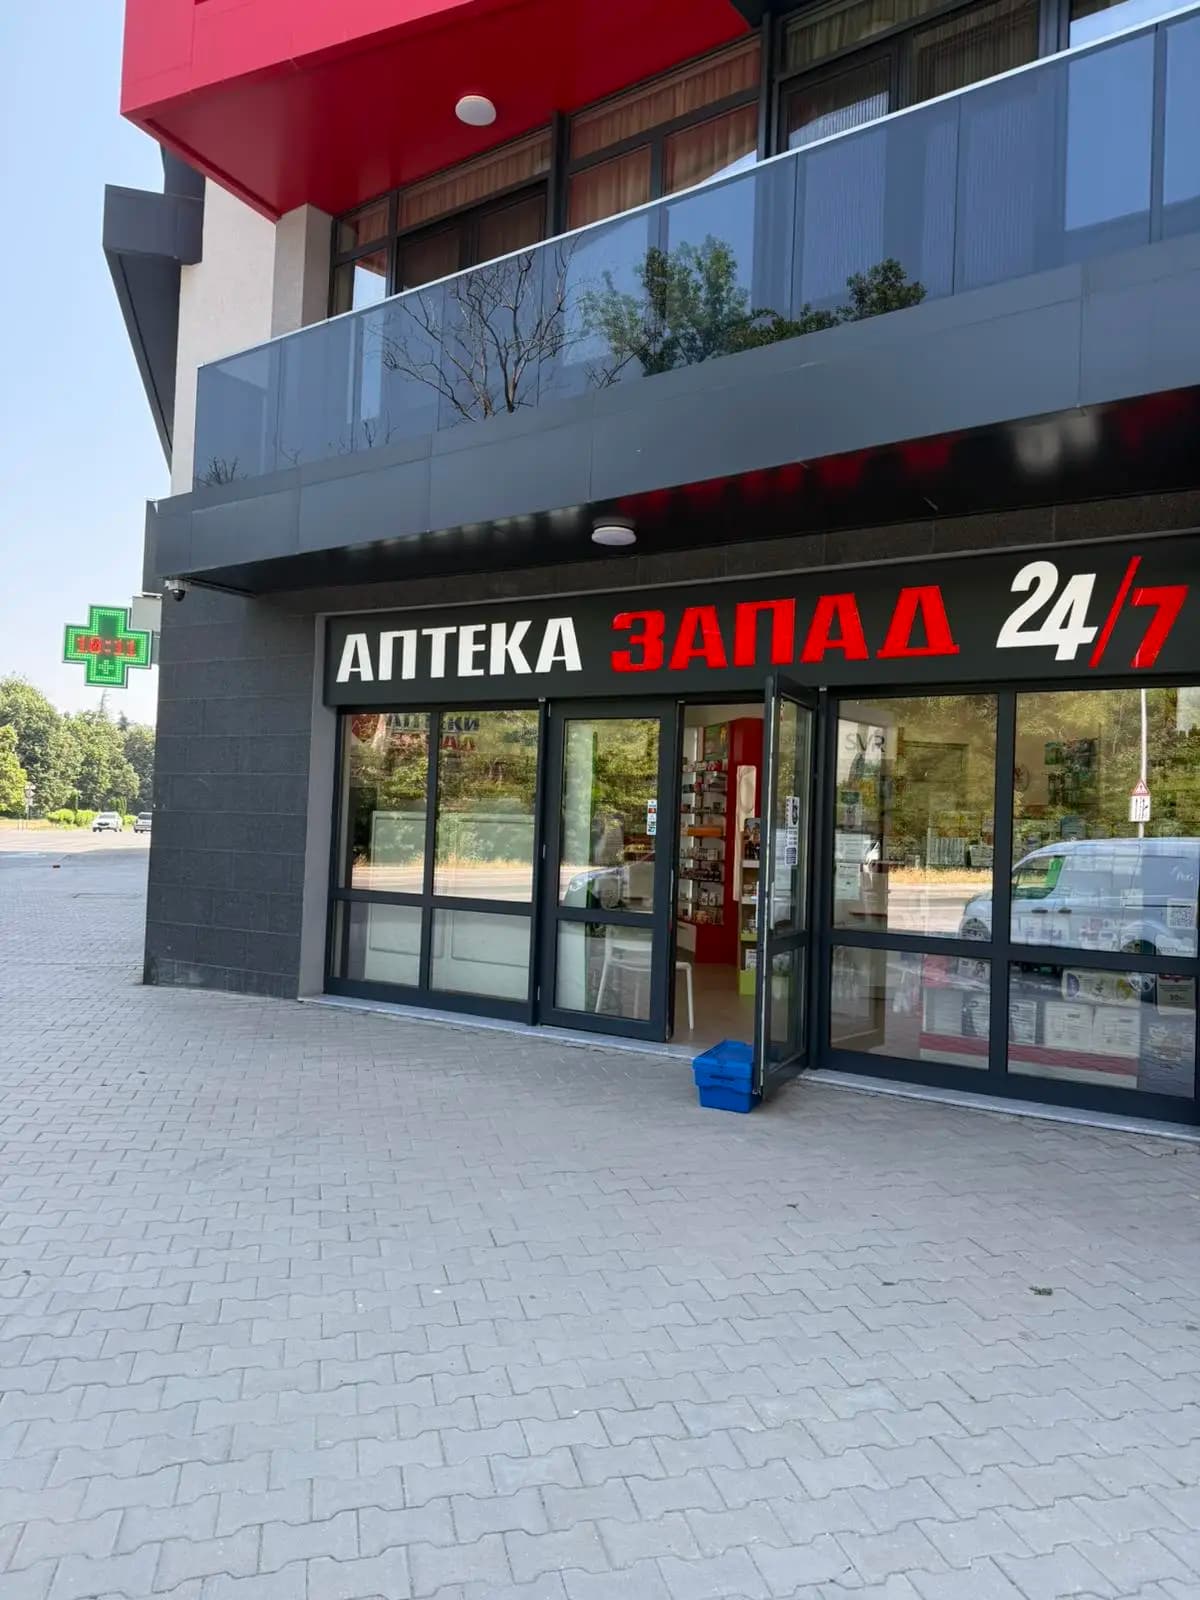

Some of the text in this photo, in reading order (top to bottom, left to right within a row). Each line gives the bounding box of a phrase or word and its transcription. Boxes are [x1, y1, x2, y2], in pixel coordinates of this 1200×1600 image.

[336, 555, 1190, 683] АПТЕКА ЗАПАД 24/7
